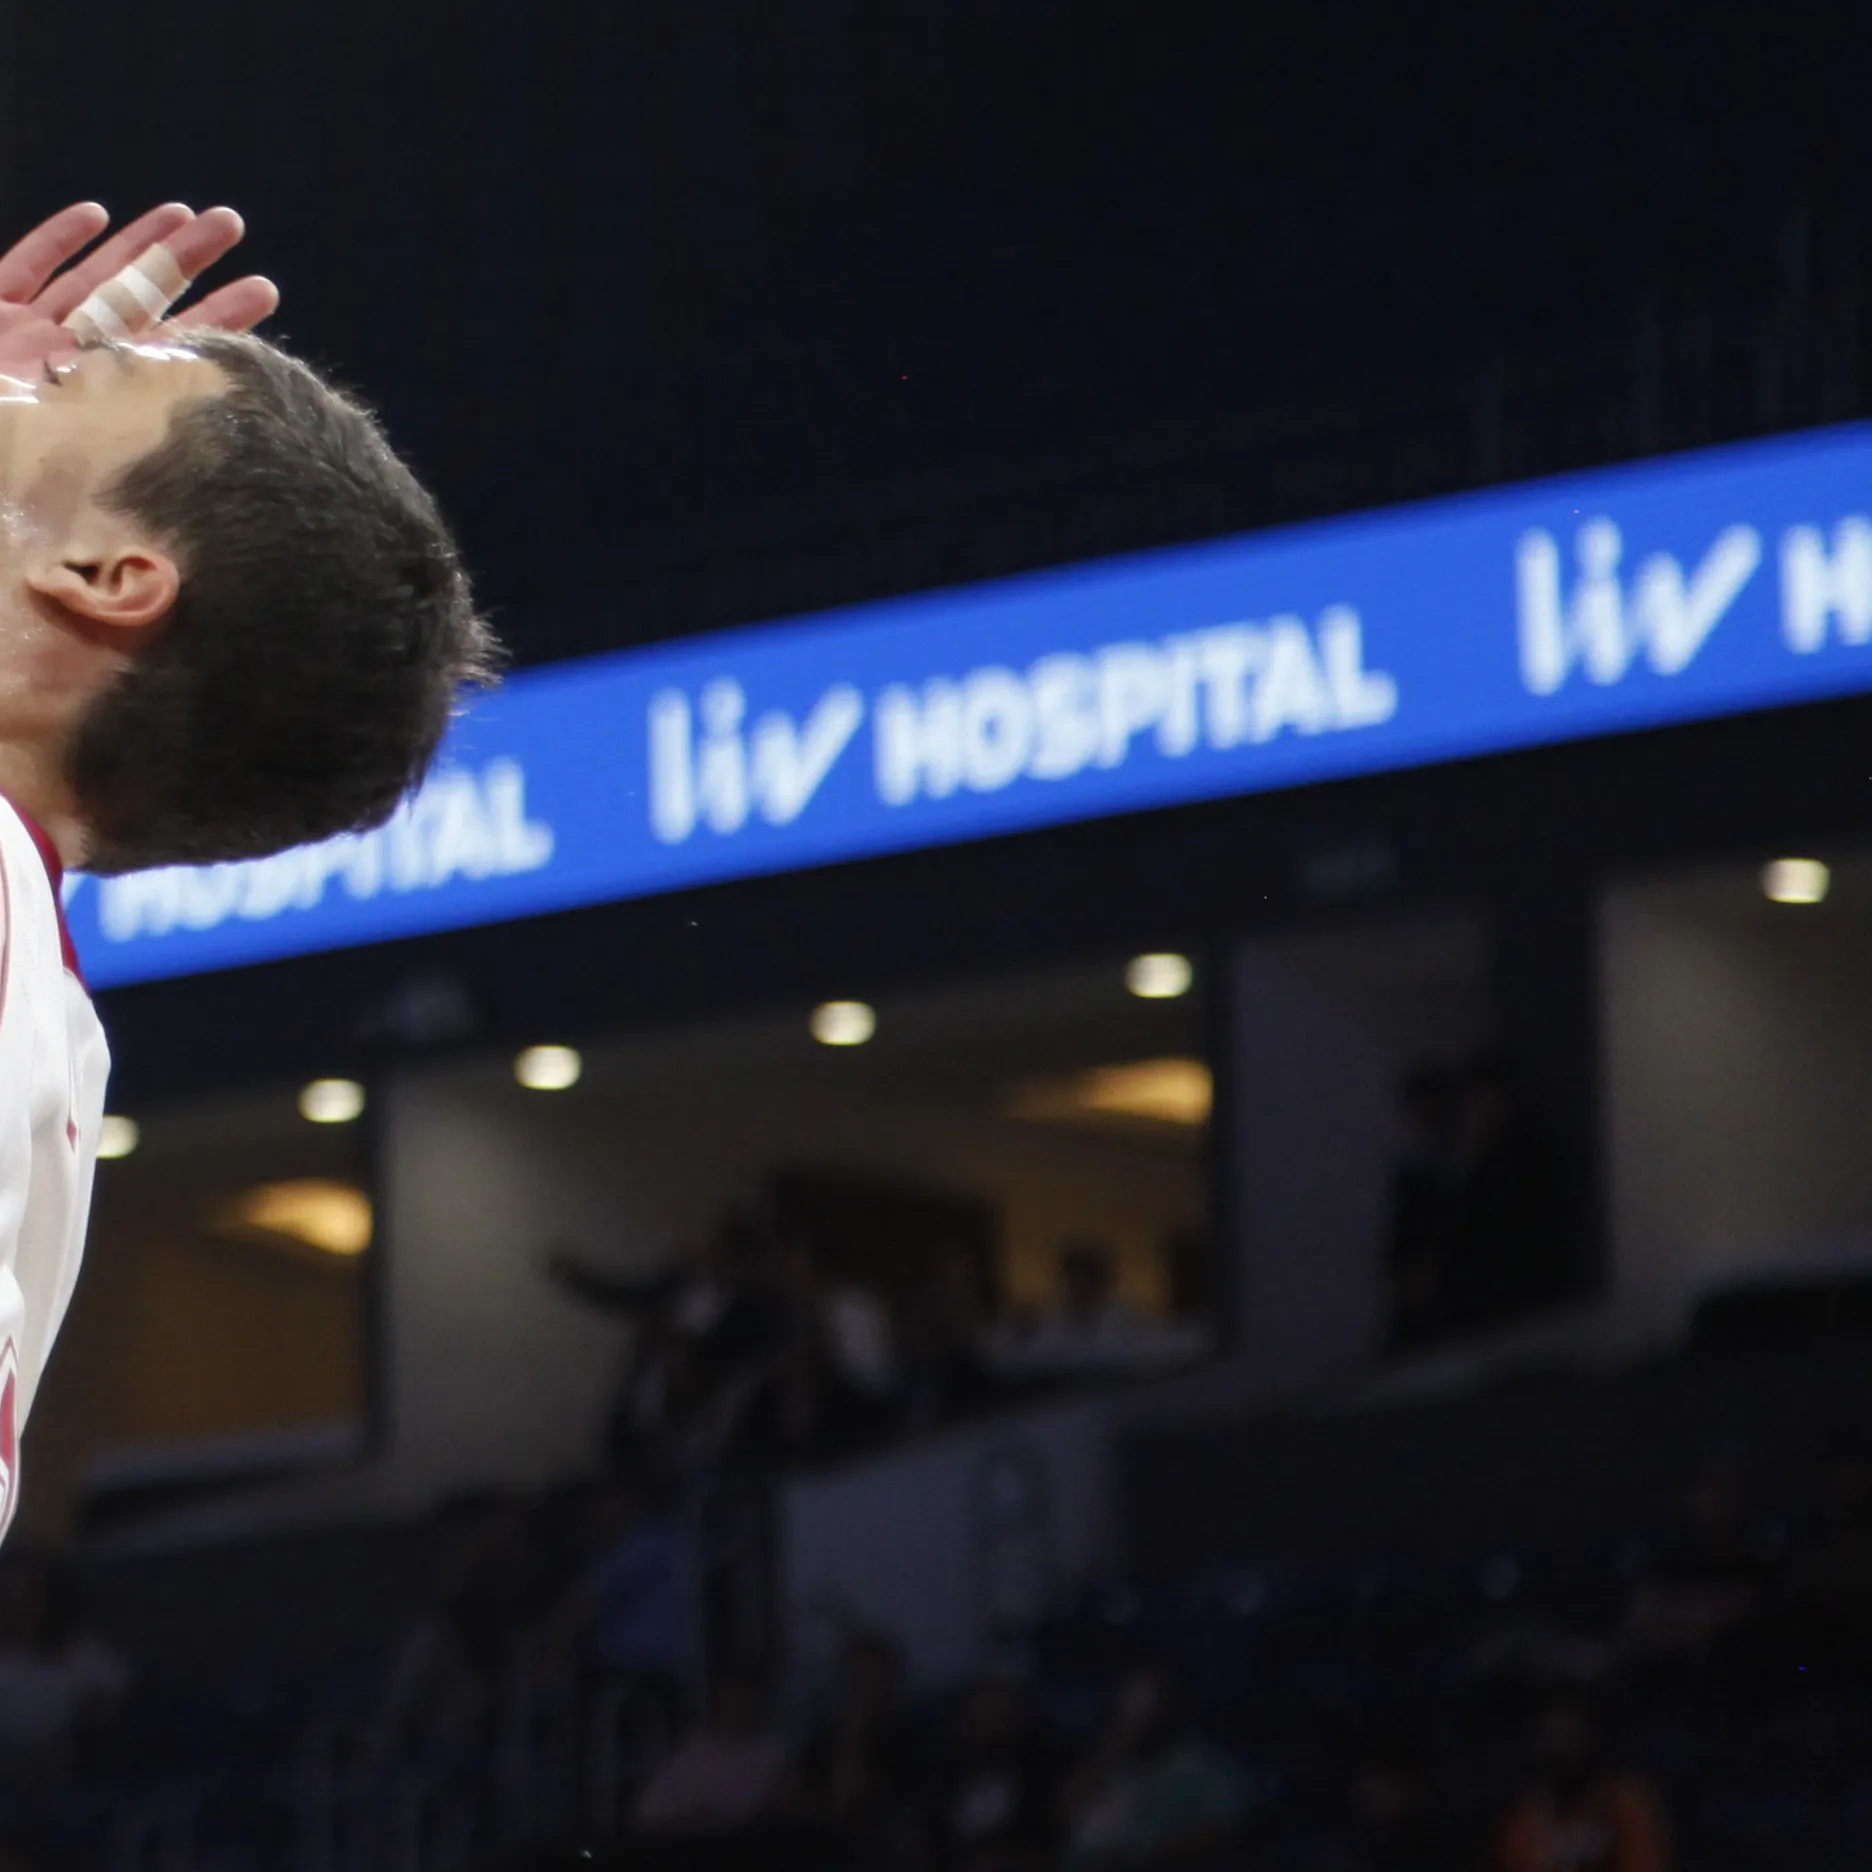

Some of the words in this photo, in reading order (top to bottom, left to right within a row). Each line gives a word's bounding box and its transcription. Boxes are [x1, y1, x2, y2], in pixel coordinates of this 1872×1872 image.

[646, 674, 866, 846] liv
[874, 602, 1399, 807] HOSPITAL
[1516, 514, 1762, 696] liv
